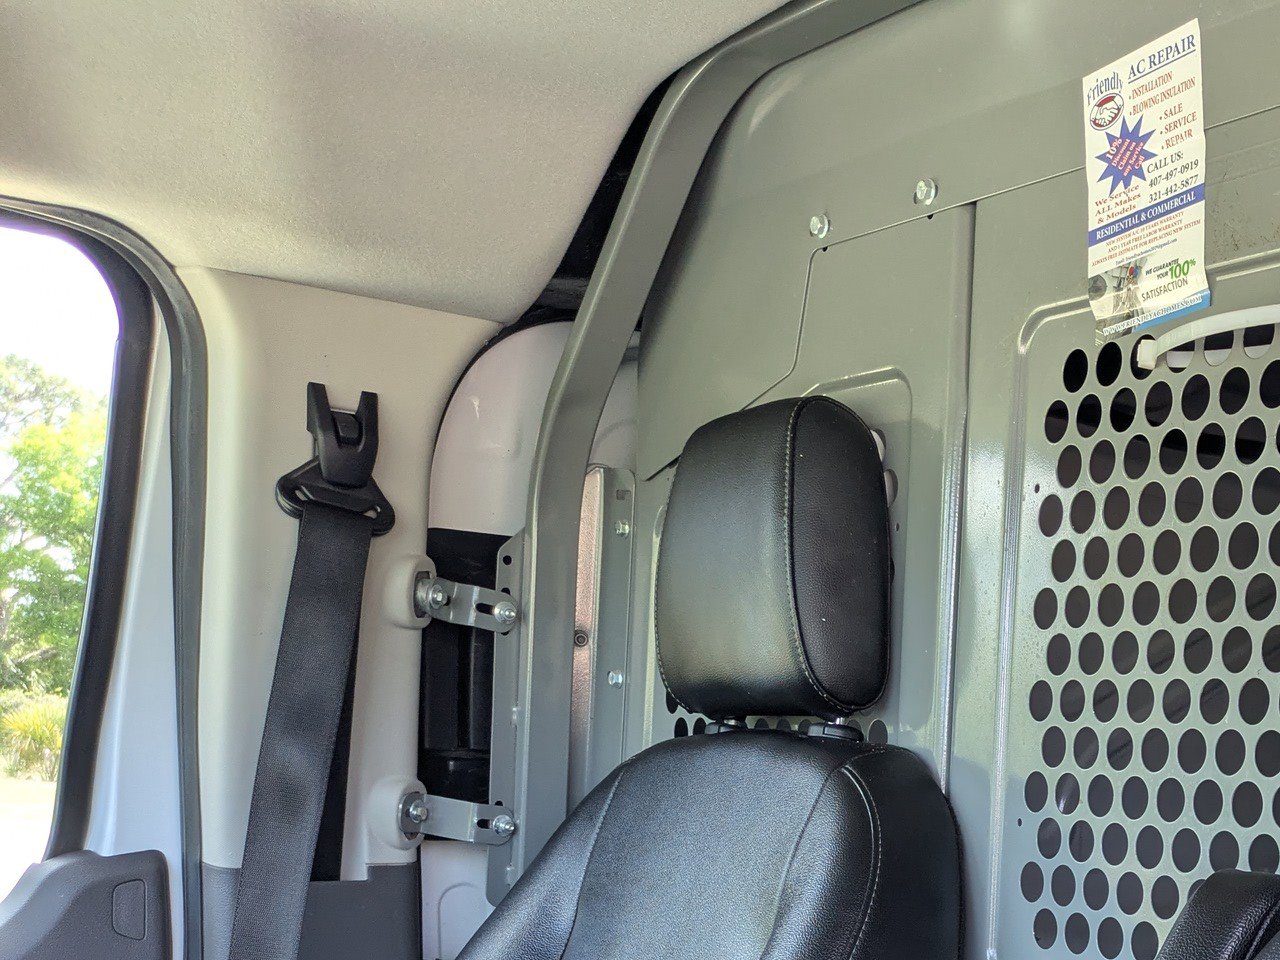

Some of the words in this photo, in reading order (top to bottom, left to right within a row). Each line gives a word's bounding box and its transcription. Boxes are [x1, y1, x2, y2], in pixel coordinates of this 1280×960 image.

[1128, 59, 1146, 80] AC
[1148, 34, 1196, 69] REPAIR
[1087, 72, 1123, 106] Friendly
[1131, 71, 1173, 100] INSTALLATION
[1132, 94, 1160, 116] BLOWING
[1160, 76, 1196, 104] INSULATION
[1163, 103, 1183, 120] SALE
[1164, 111, 1197, 135] SERVICE
[1106, 138, 1122, 159] 10%
[1165, 129, 1193, 149] REPAIR
[1129, 142, 1144, 164] Service
[1147, 155, 1170, 173] CALL
[1170, 151, 1184, 164] US:
[1148, 159, 1199, 188] 407-497-0919
[1095, 198, 1108, 207] We
[1109, 184, 1140, 202] Service
[1148, 174, 1199, 203] 321-442-5877
[1095, 204, 1112, 217] ALL
[1115, 192, 1141, 208] Makes
[1096, 214, 1140, 240] RESIDENTIAL
[1140, 212, 1147, 223] &
[1147, 191, 1196, 219] COMMERCIAL
[1106, 203, 1137, 221] Models
[1152, 258, 1179, 273] GUARANTEE
[1157, 270, 1169, 280] YOUR
[1168, 258, 1197, 280] 100%
[1141, 277, 1188, 302] SATISFACTION
